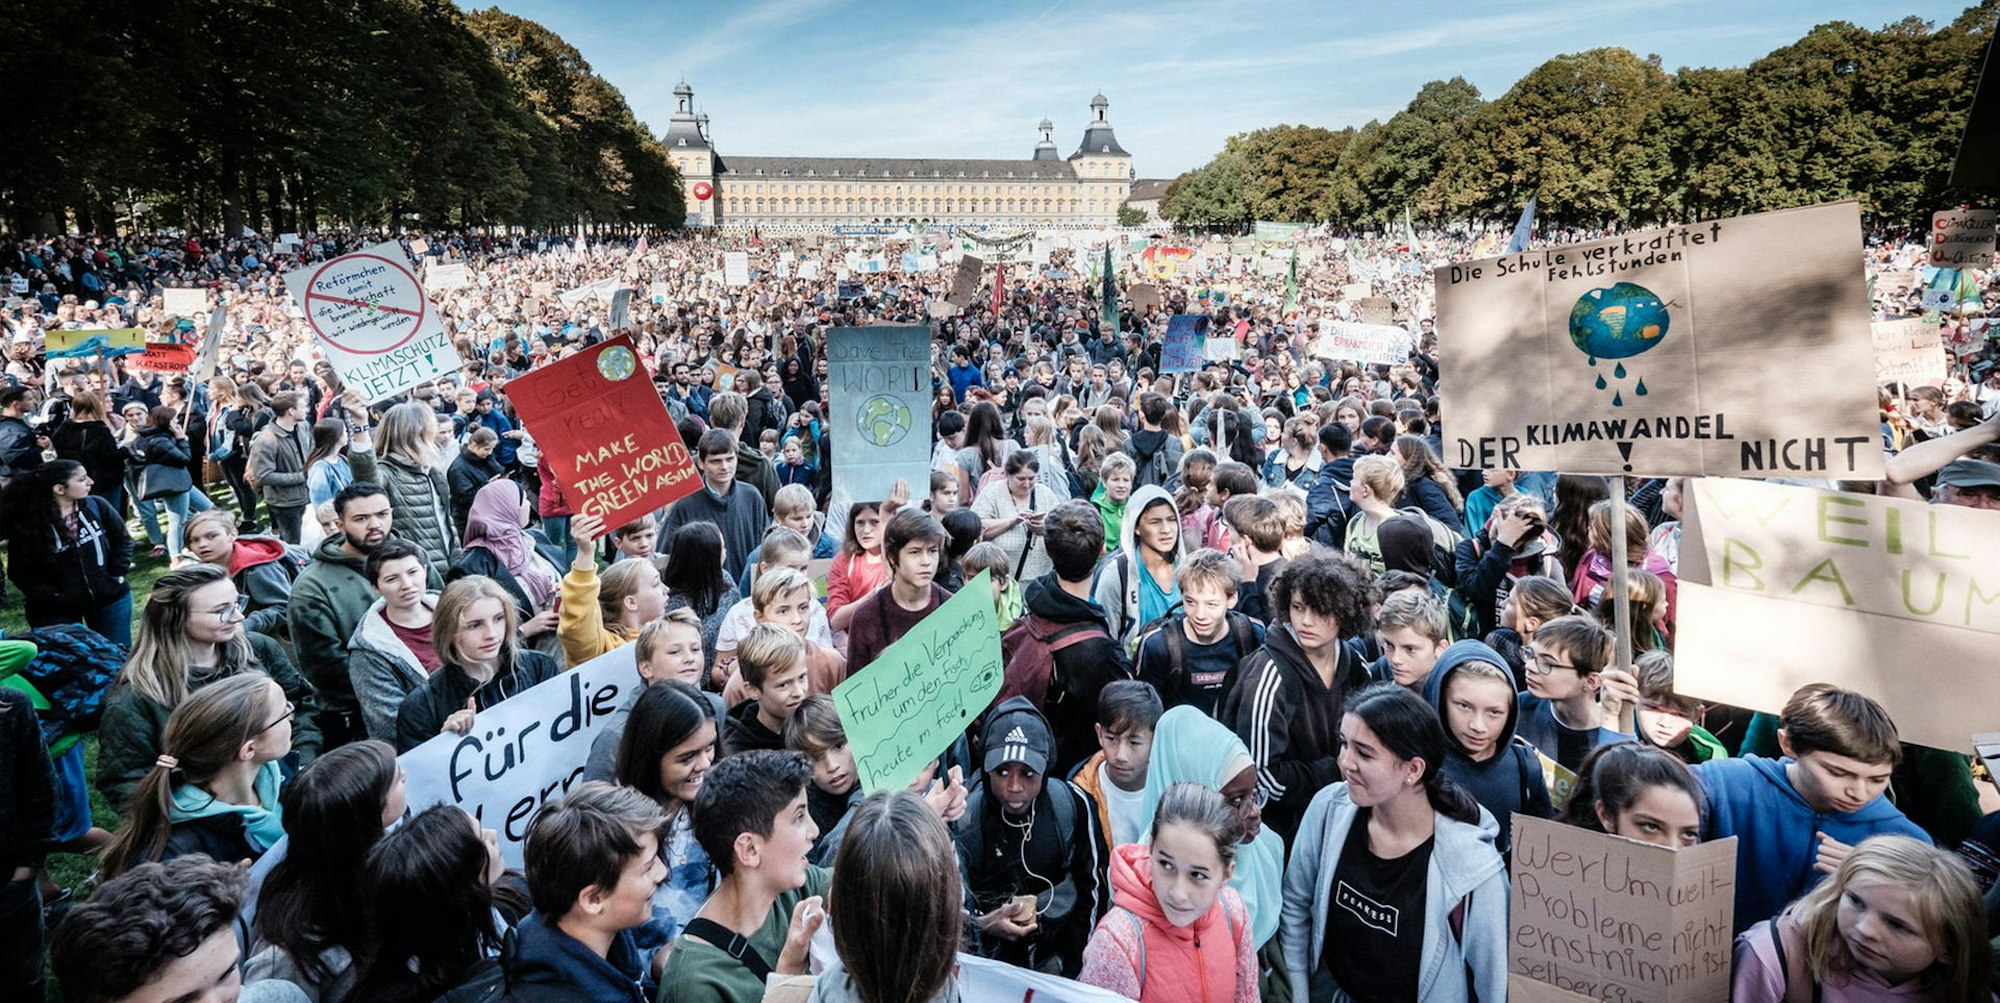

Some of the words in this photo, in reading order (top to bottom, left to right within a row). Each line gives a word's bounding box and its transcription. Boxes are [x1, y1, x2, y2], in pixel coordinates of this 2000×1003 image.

[1451, 266, 1482, 285] Die
[1497, 251, 1565, 277] Schule
[1583, 222, 1722, 260] verkraftet
[1548, 250, 1682, 282] Fehlstunden
[316, 265, 386, 291] Reförmchen
[347, 280, 373, 295] damit
[330, 306, 363, 323] brummt
[381, 316, 411, 331] werden
[344, 331, 448, 385] KLIMASCHUTZ
[834, 339, 880, 360] Save
[533, 362, 596, 408] Get
[842, 365, 930, 393] WORLD
[575, 433, 640, 473] MAKE
[1458, 436, 1520, 469] DER
[1527, 413, 1734, 446] KLIMAWANDEL
[1741, 436, 1870, 471] NICHT
[574, 472, 615, 496] THE
[621, 442, 688, 479] WORLD
[581, 475, 649, 517] GREEN
[1704, 490, 1972, 560] WEIL
[844, 677, 900, 726] Früher
[902, 661, 924, 688] die
[922, 610, 986, 666] Verpackung
[892, 699, 916, 719] um
[917, 677, 941, 702] den
[449, 720, 540, 804] für
[550, 672, 618, 742] die
[864, 745, 913, 789] heute
[936, 688, 968, 729] Fisch!
[1516, 826, 1598, 882] Wer
[1518, 872, 1662, 951] Probleme
[1672, 908, 1727, 954] nicht
[1516, 956, 1598, 998] selber
[1702, 951, 1729, 975] ist
